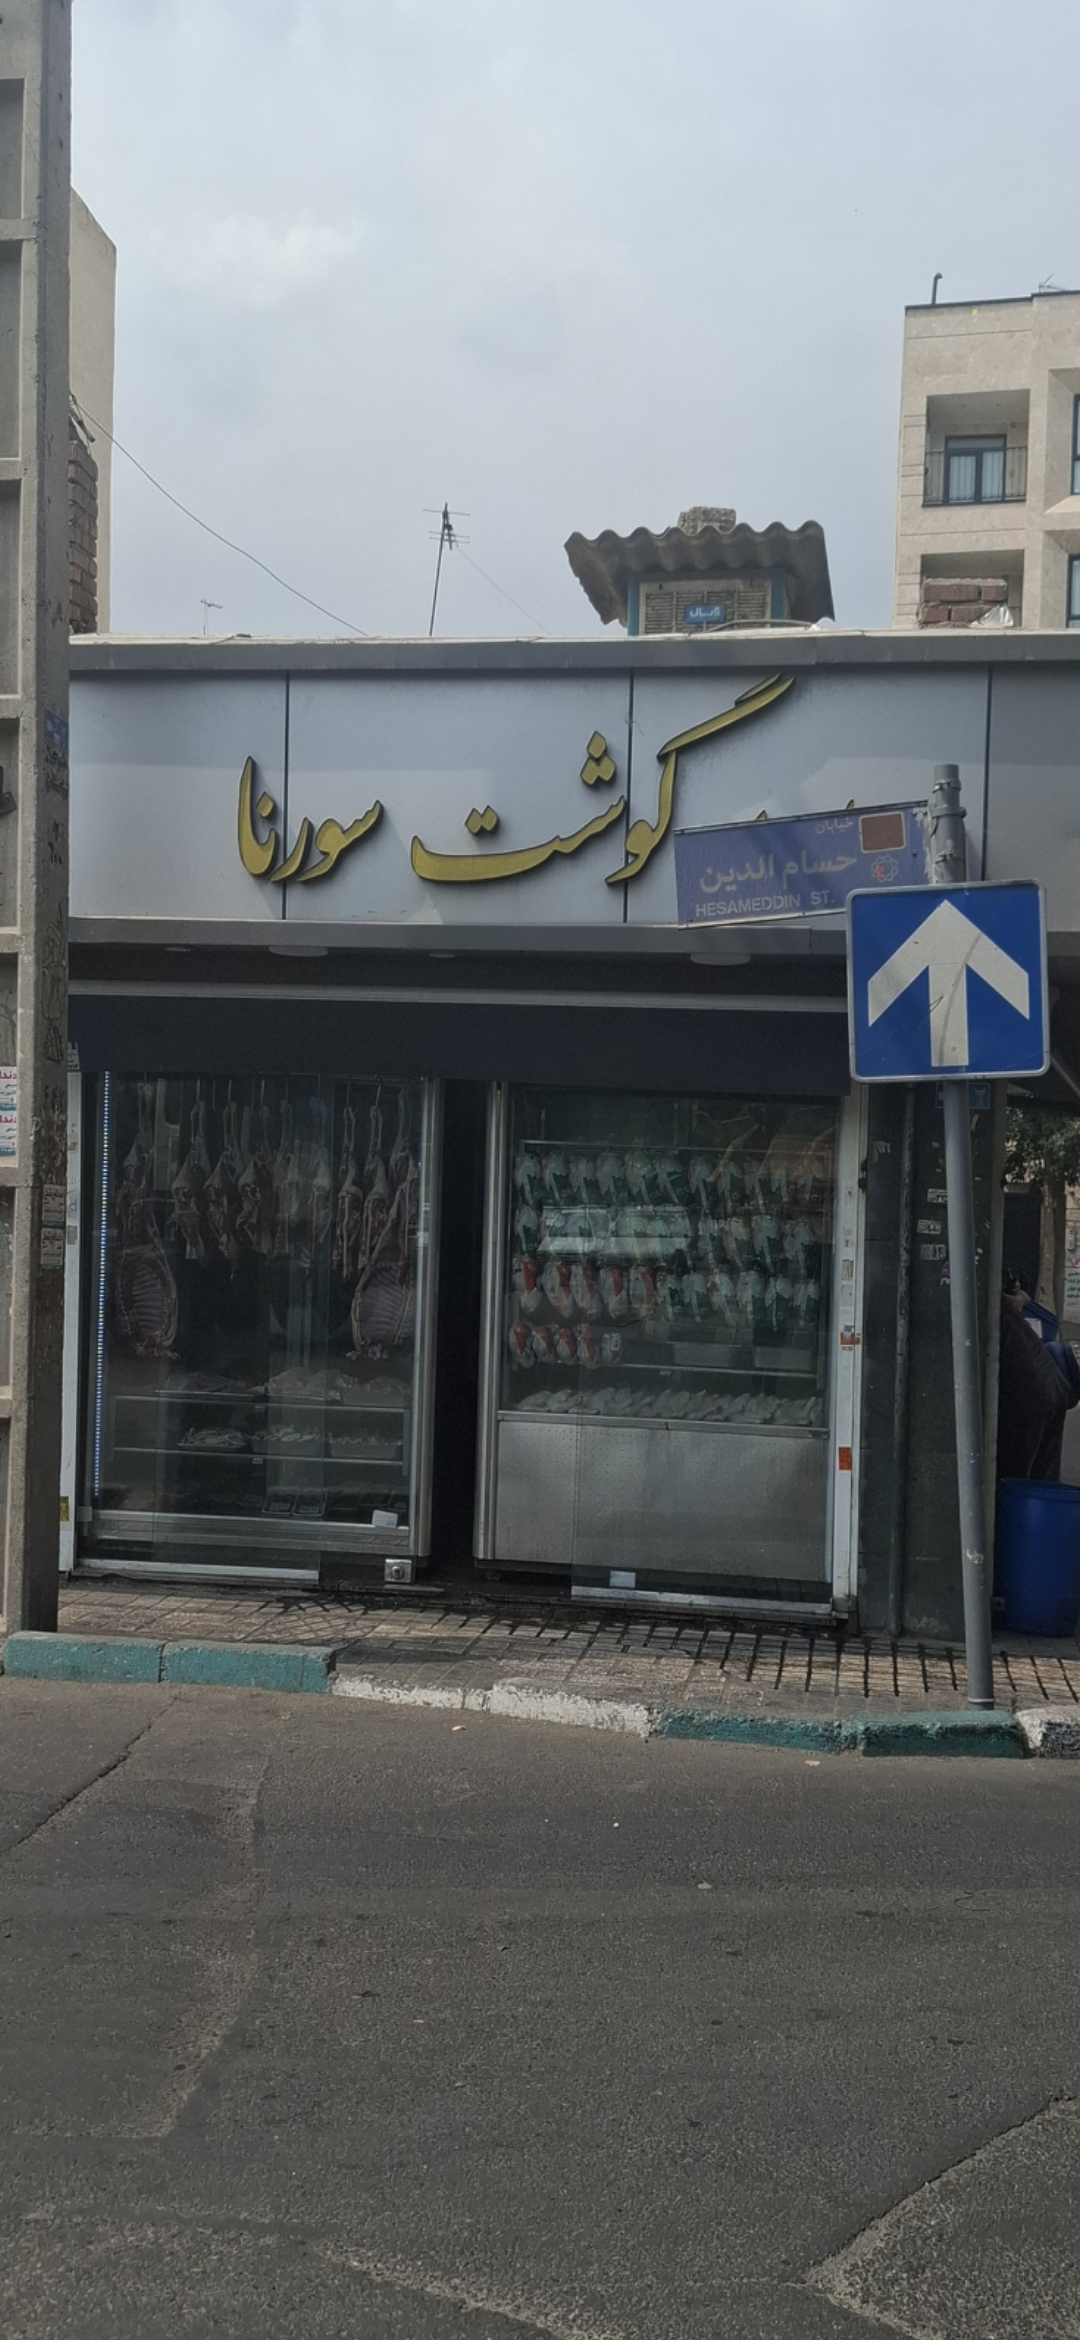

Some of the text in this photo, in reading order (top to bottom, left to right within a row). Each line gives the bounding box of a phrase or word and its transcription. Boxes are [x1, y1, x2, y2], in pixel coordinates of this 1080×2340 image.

[237, 673, 795, 884] گوشت سورنا
[815, 817, 855, 835] خیابان
[700, 849, 857, 893] حسام الدین
[695, 890, 835, 918] HESAMEDDIN ST.
